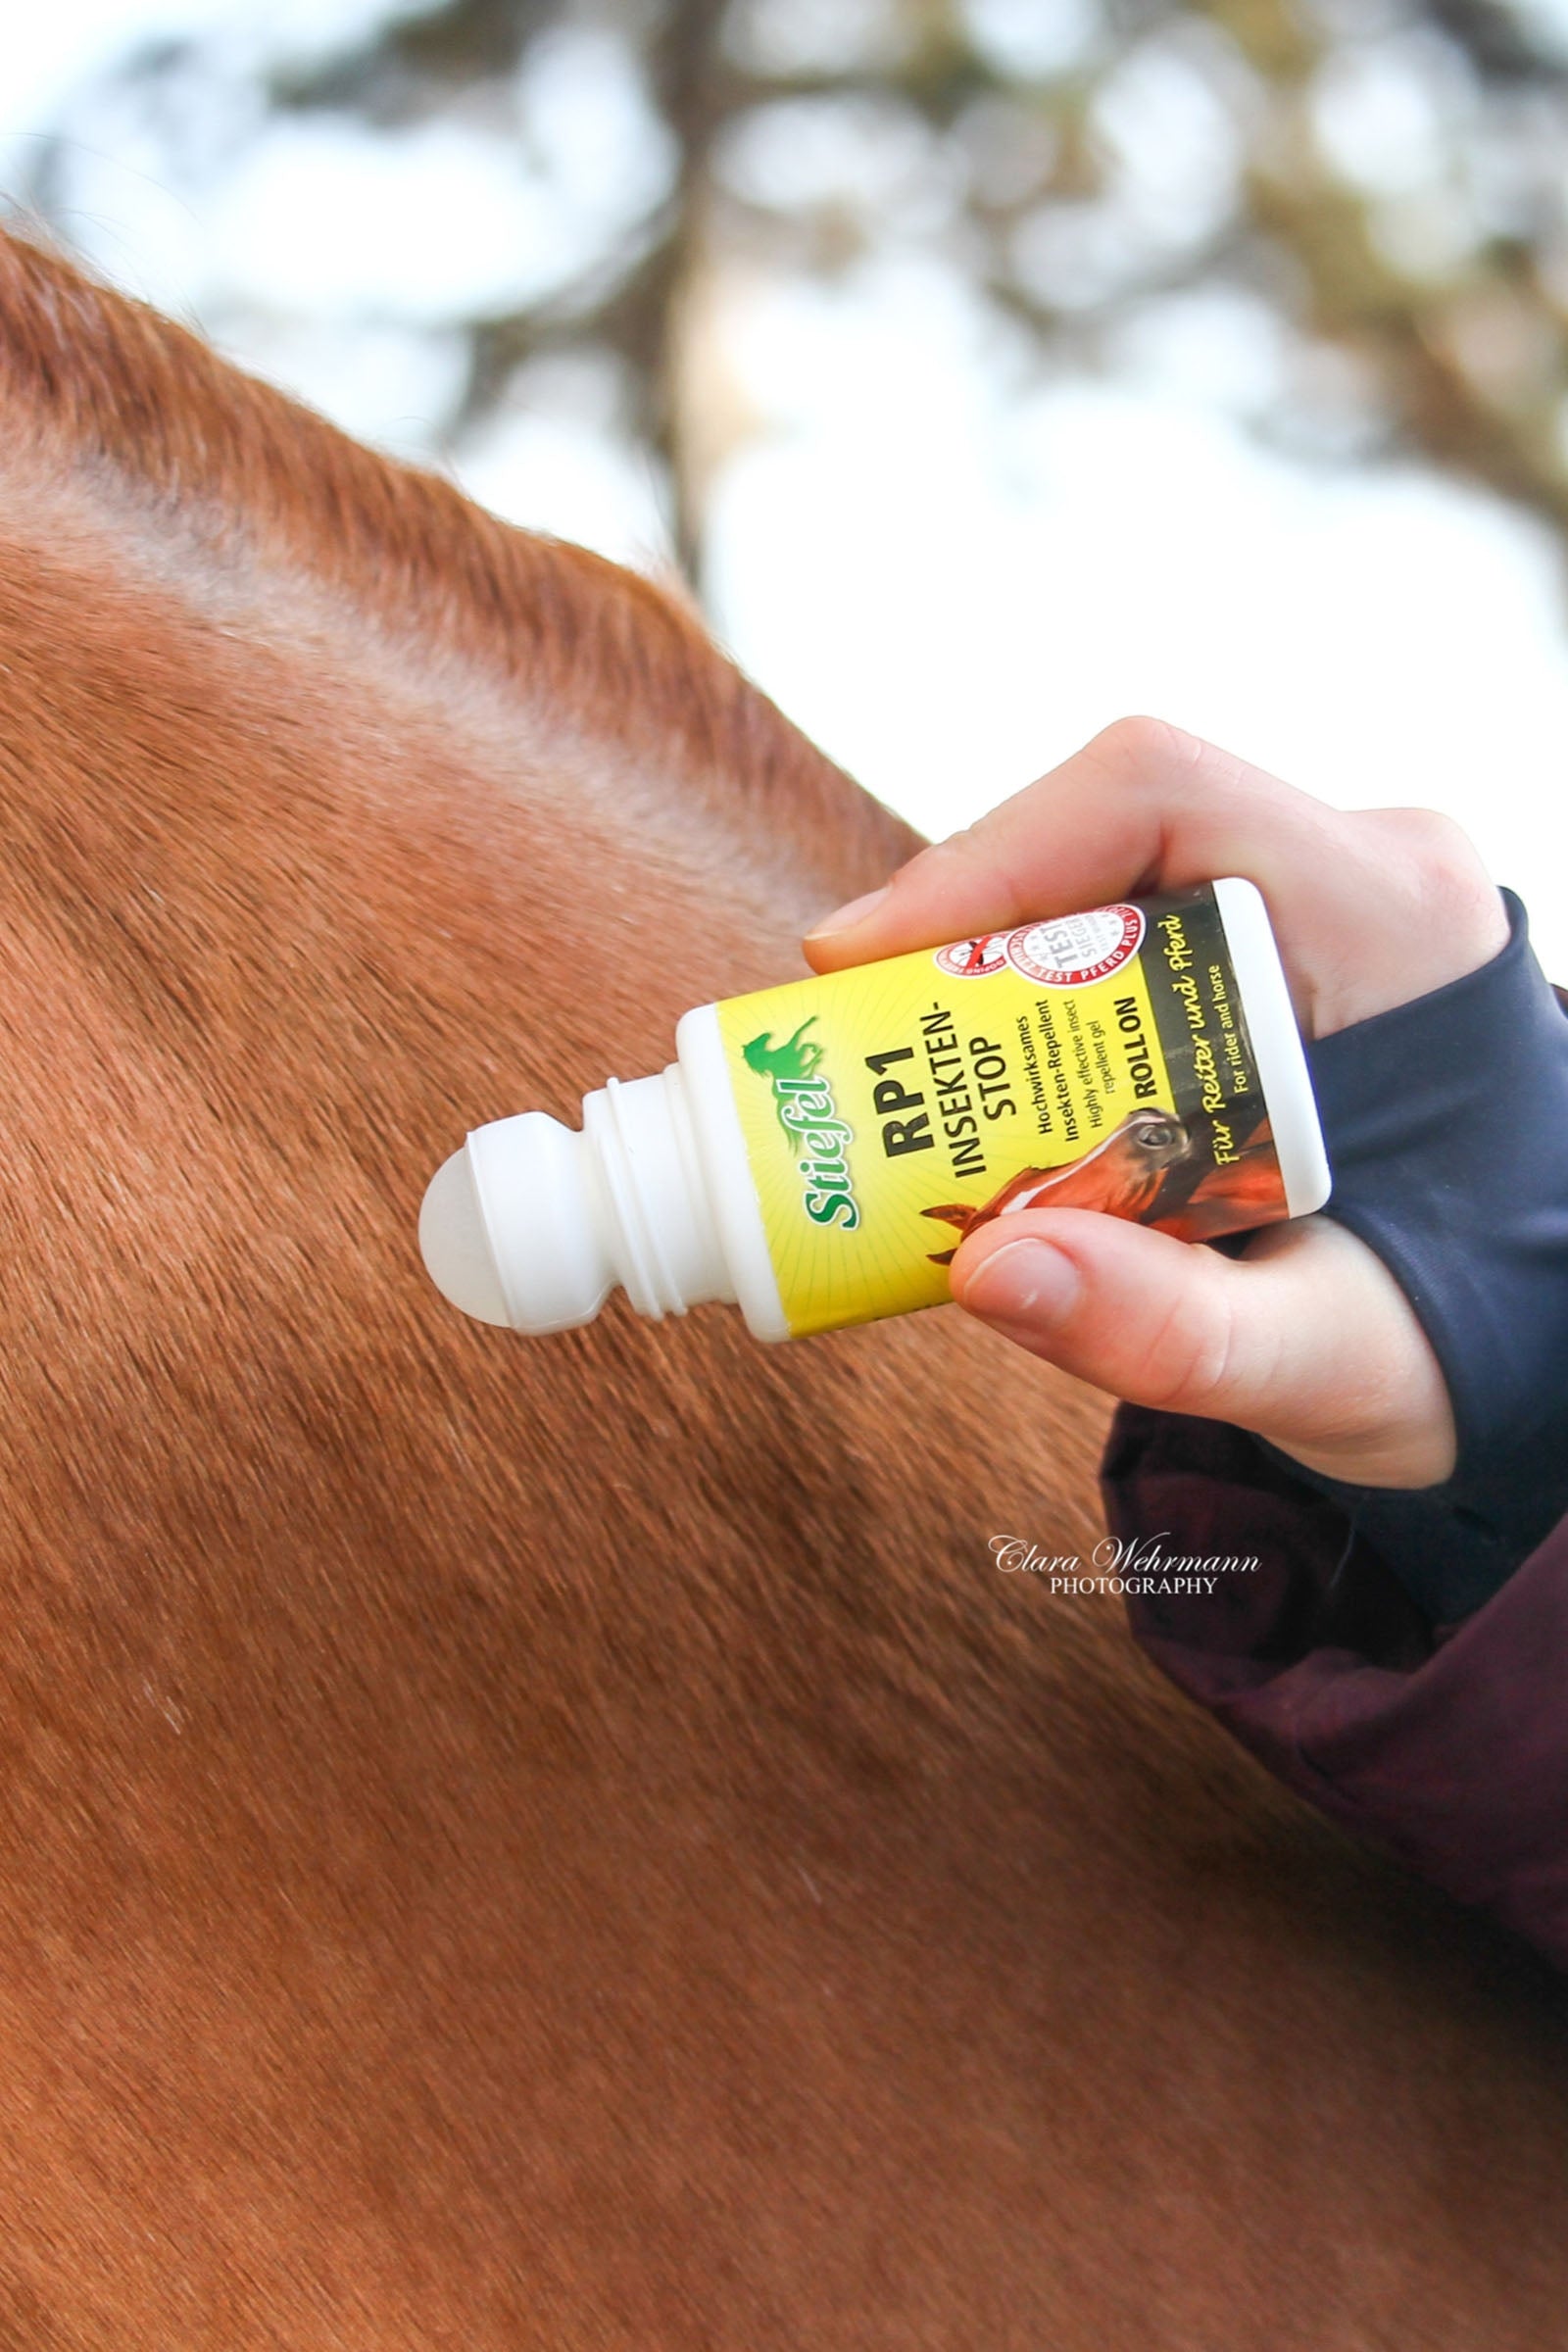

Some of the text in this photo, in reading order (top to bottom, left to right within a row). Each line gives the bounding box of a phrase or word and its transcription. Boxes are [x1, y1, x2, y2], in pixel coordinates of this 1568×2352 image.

[1038, 923, 1079, 969] TEST
[1080, 950, 1125, 981] PFERD
[1121, 918, 1139, 948] PLUS
[968, 1036, 1017, 1121] STOP
[1016, 1015, 1054, 1135] Hochwirksames
[1035, 999, 1080, 1142] Insekten-Repellent
[1062, 999, 1103, 1128] Highly effective insect
[1086, 1020, 1117, 1095] repellent gel
[1113, 996, 1158, 1100] ROLL ON
[1156, 914, 1241, 1166] Für Reiter und Pferd
[1207, 963, 1250, 1094] For rider and horse
[864, 1046, 935, 1158] RP1
[919, 1002, 987, 1178] INSEKTEN-
[776, 1076, 859, 1229] Stiefel
